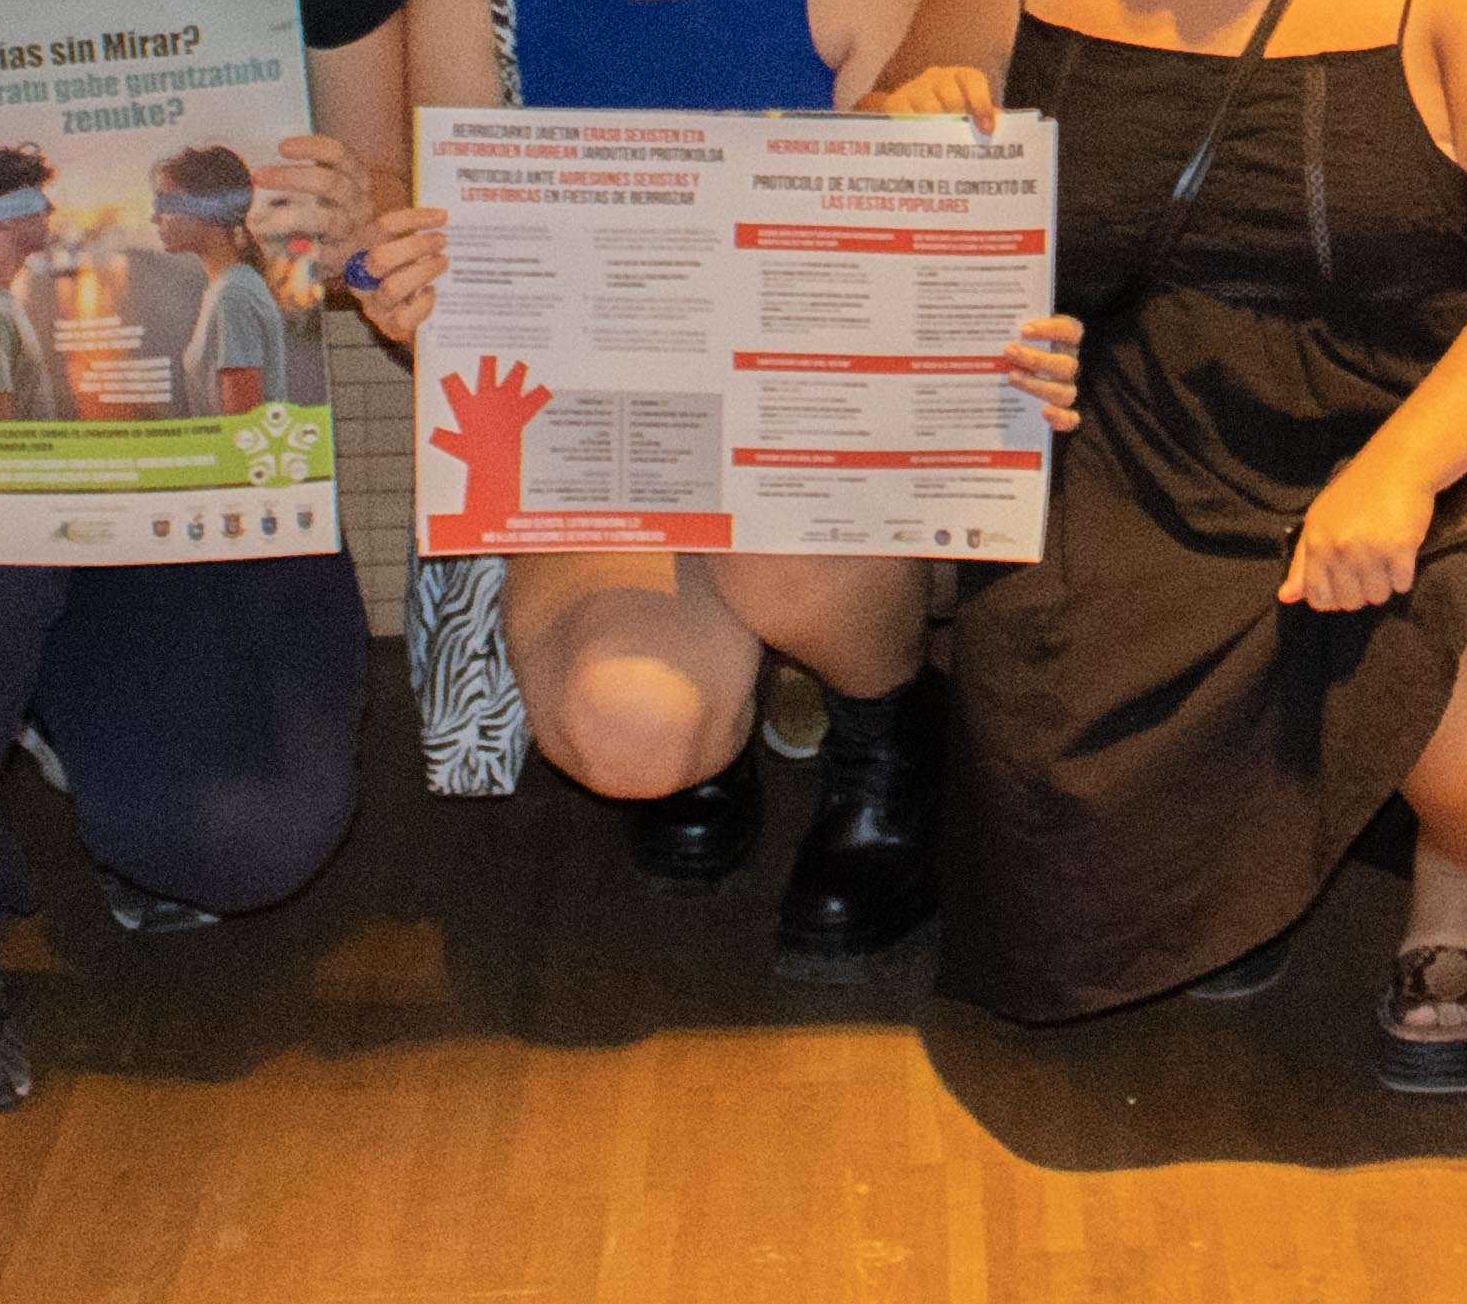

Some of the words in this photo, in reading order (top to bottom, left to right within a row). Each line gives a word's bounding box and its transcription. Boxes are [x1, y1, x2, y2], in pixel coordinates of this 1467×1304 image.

[49, 36, 96, 67] sin
[101, 25, 201, 62] Mirar?
[54, 72, 120, 105] gabe
[124, 55, 281, 95] gurutzatuko
[62, 97, 184, 135] zenuke?
[535, 126, 580, 140] JAIETAN
[583, 127, 621, 141] ERASO
[624, 128, 680, 142] SEXISTEN
[683, 129, 705, 143] ETA
[525, 144, 578, 159] AURREAN
[766, 139, 820, 155] HERRIKO
[824, 140, 871, 156] JAIETAN
[874, 141, 943, 158] JARDUTEKO
[457, 168, 523, 184] PROTOCOLO
[527, 170, 555, 185] ANTE
[559, 170, 631, 186] AGRESIONES
[634, 172, 688, 187] SEXISTAS
[691, 173, 700, 187] Y
[753, 175, 824, 191] PROTOCOLO
[828, 177, 844, 192] DE
[918, 178, 934, 193] EN
[938, 178, 952, 194] EL
[955, 179, 1018, 196] CONTEXTO
[1022, 179, 1038, 195] DE
[544, 189, 559, 204] EN
[562, 189, 609, 204] FIESTAS
[612, 191, 626, 205] DE
[821, 196, 844, 211] LAS
[848, 196, 895, 212] FIESTAS
[899, 197, 969, 214] POPULARES
